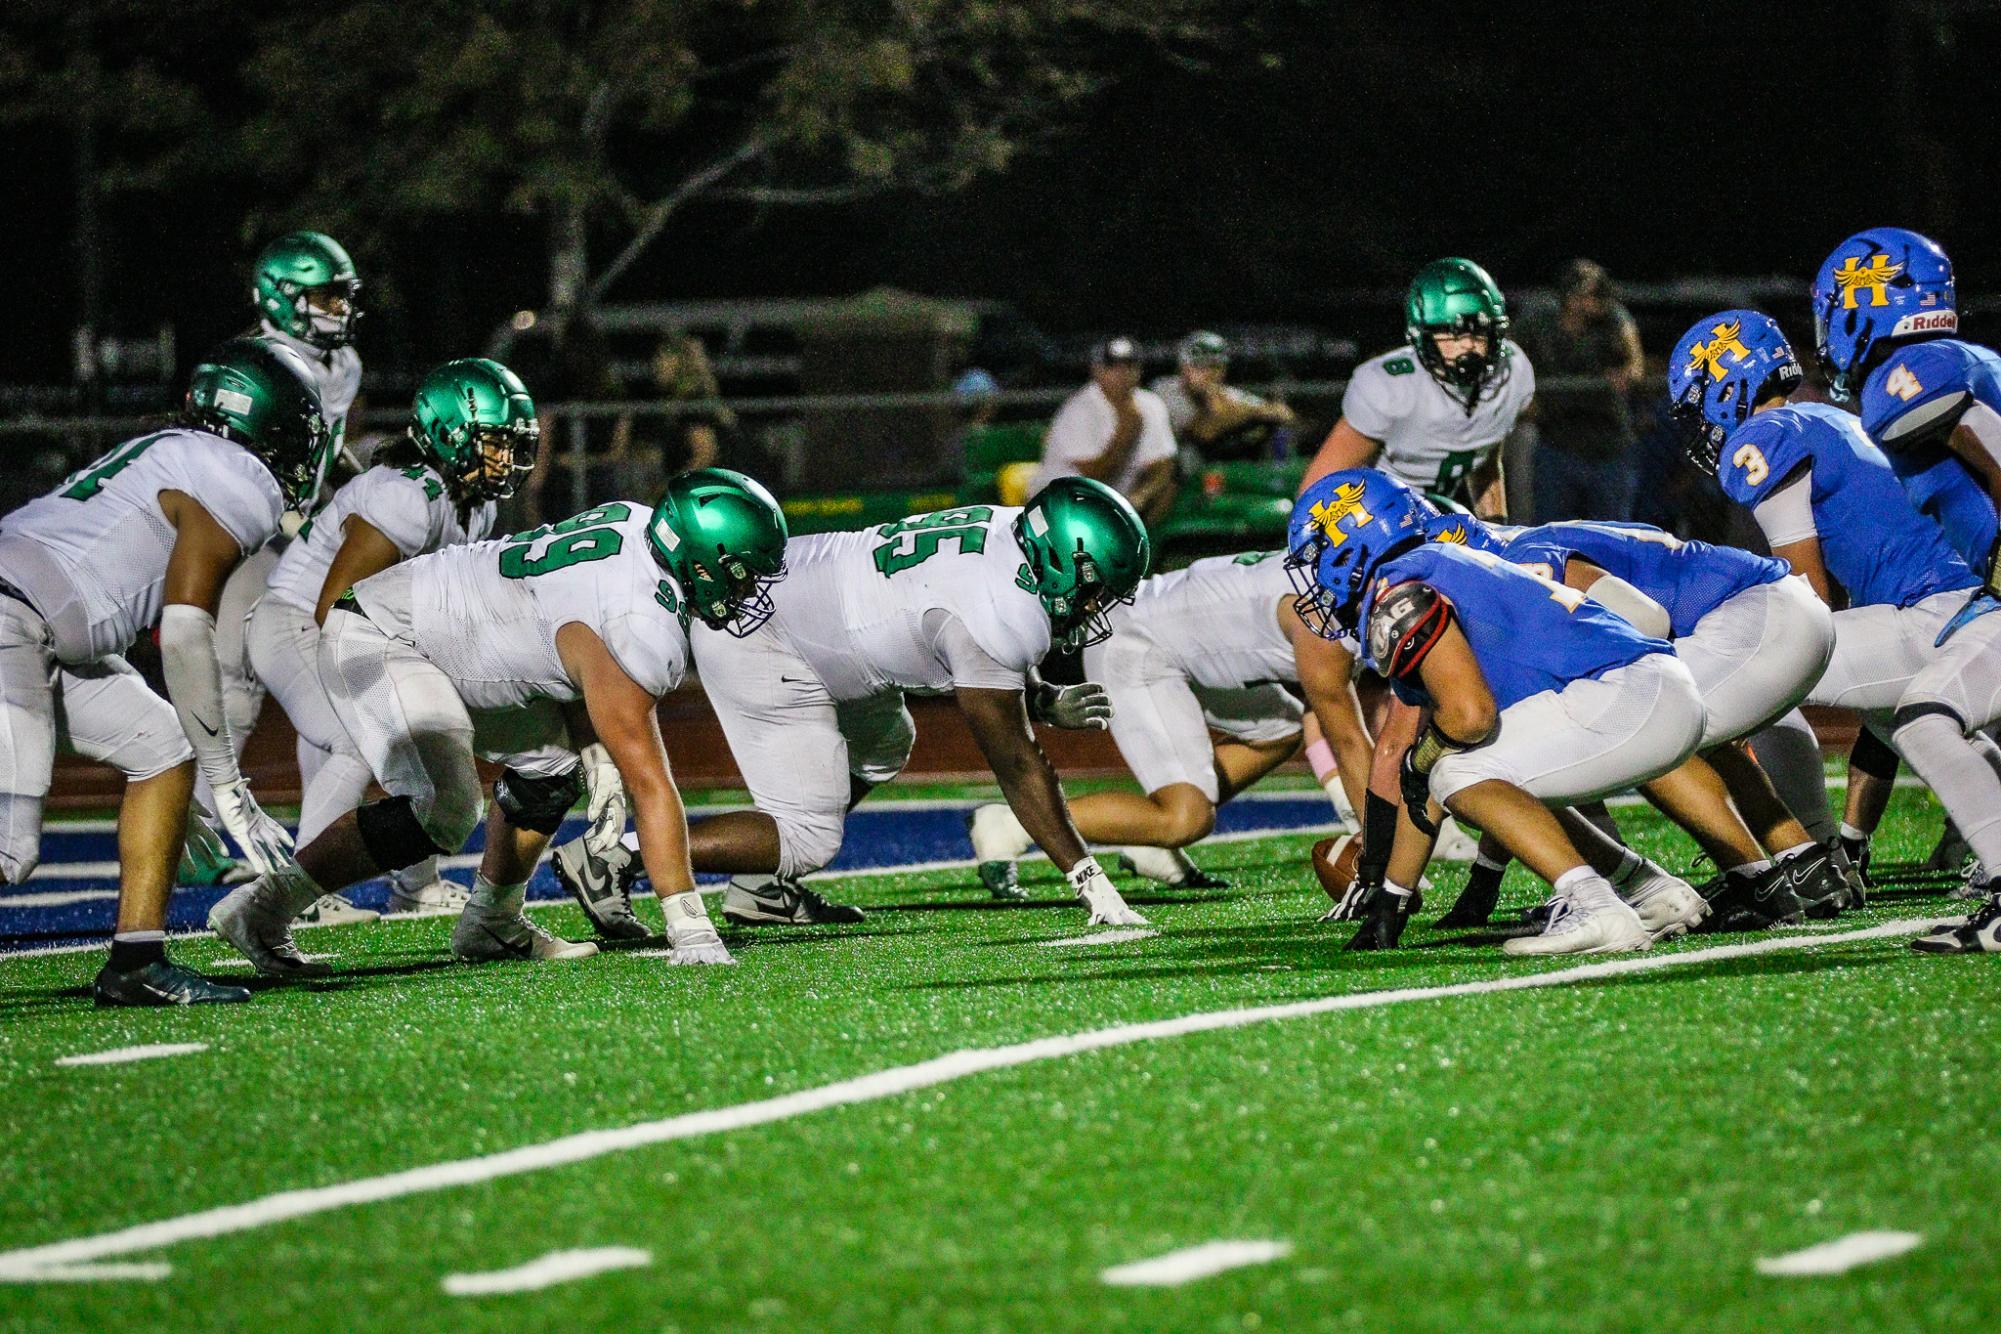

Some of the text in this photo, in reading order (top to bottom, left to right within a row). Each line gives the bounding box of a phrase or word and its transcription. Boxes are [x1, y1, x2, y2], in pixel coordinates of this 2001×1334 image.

[1383, 357, 1415, 376] 8
[1886, 363, 1923, 401] 4
[1733, 443, 1769, 486] 3
[872, 506, 994, 578] 95
[1075, 864, 1096, 885] NIKE
